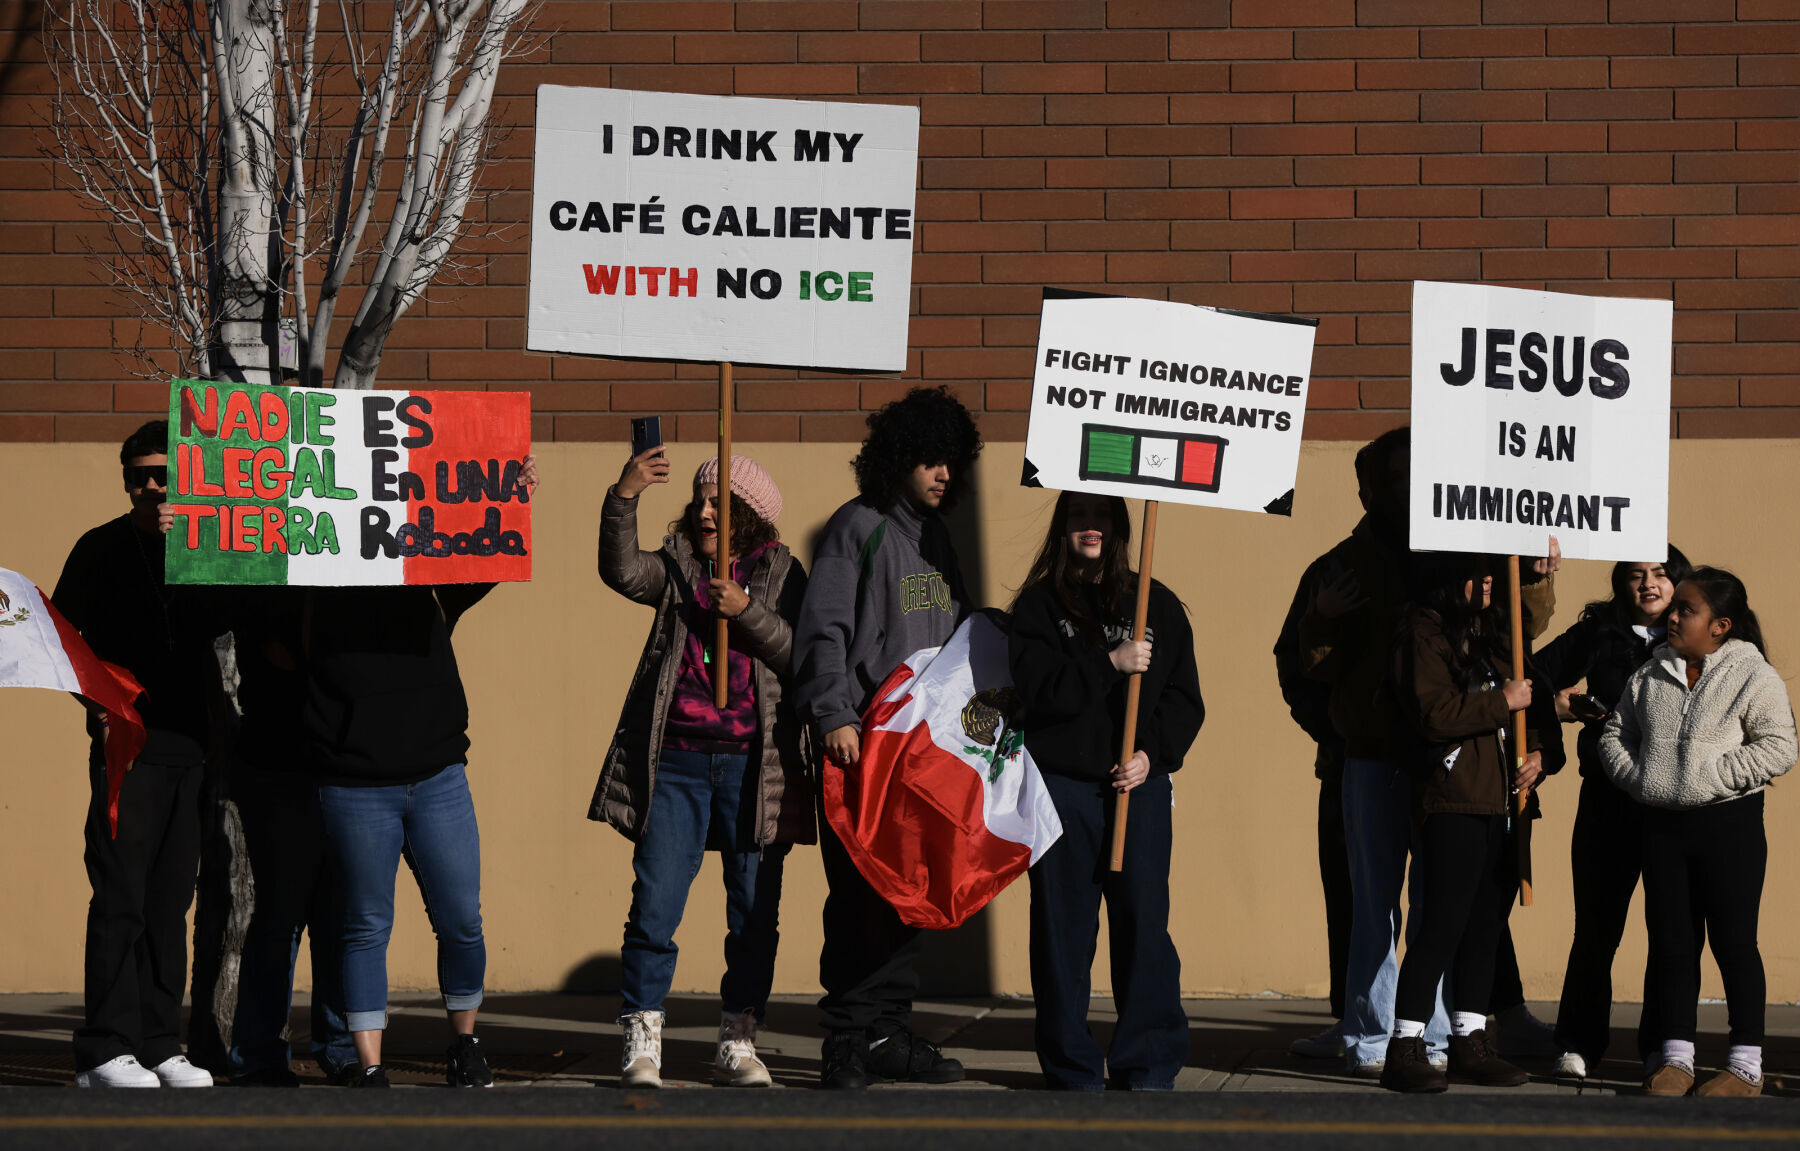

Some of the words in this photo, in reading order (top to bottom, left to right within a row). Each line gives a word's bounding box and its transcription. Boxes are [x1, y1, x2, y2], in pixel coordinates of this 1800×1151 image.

[602, 124, 613, 154] I
[632, 125, 777, 162] DRINK
[794, 129, 864, 162] MY
[549, 195, 665, 234] CAFÉ
[682, 204, 912, 240] CALIENTE
[582, 263, 698, 298] WITH
[716, 268, 782, 299] NO
[799, 270, 874, 302] ICE
[1045, 348, 1131, 375] FIGHT
[1139, 358, 1303, 397] IGNORANCE
[1440, 327, 1630, 400] JESUS
[180, 386, 337, 446] NADIE
[362, 396, 434, 449] ES
[1046, 385, 1106, 410] NOT
[1115, 392, 1292, 432] IMMIGRANTS
[1499, 421, 1526, 457] IS
[1535, 424, 1576, 462] AN
[176, 443, 357, 500] ILEGAL
[435, 458, 530, 504] UNA
[173, 504, 340, 555] TIERRA
[360, 506, 528, 560] Robada
[1433, 483, 1630, 532] IMMIGRANT
